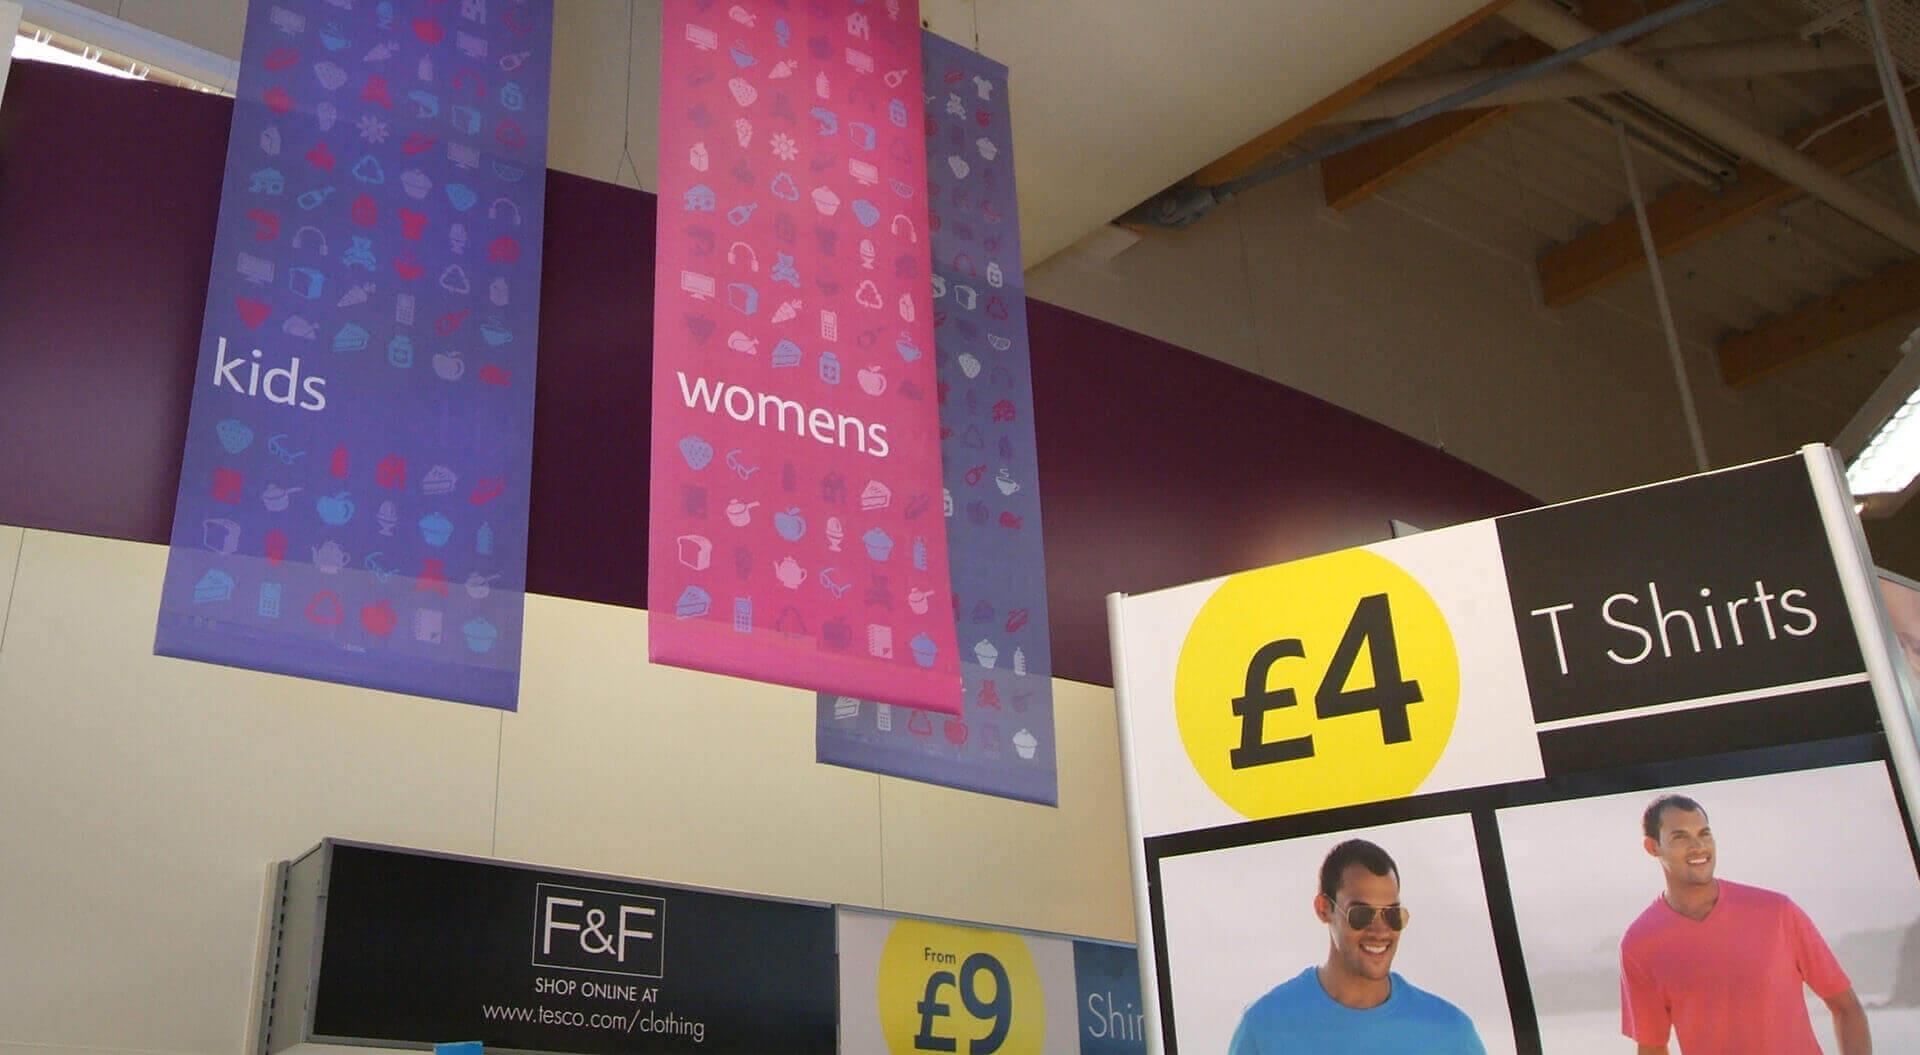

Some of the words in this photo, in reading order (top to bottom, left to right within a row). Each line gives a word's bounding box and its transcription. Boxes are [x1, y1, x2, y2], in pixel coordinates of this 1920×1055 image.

[213, 337, 326, 411] kids
[676, 371, 890, 458] womens
[1530, 603, 1574, 675] T
[1602, 580, 1819, 665] Shirts
[1229, 592, 1425, 770] £4
[542, 896, 656, 962] F&F
[924, 947, 957, 965] From
[482, 1004, 706, 1043] www.tesco.com/clothing
[535, 977, 577, 996] SHOP
[581, 982, 637, 1002] ONLINE
[641, 988, 659, 1003] AT
[913, 952, 1013, 1055] £9
